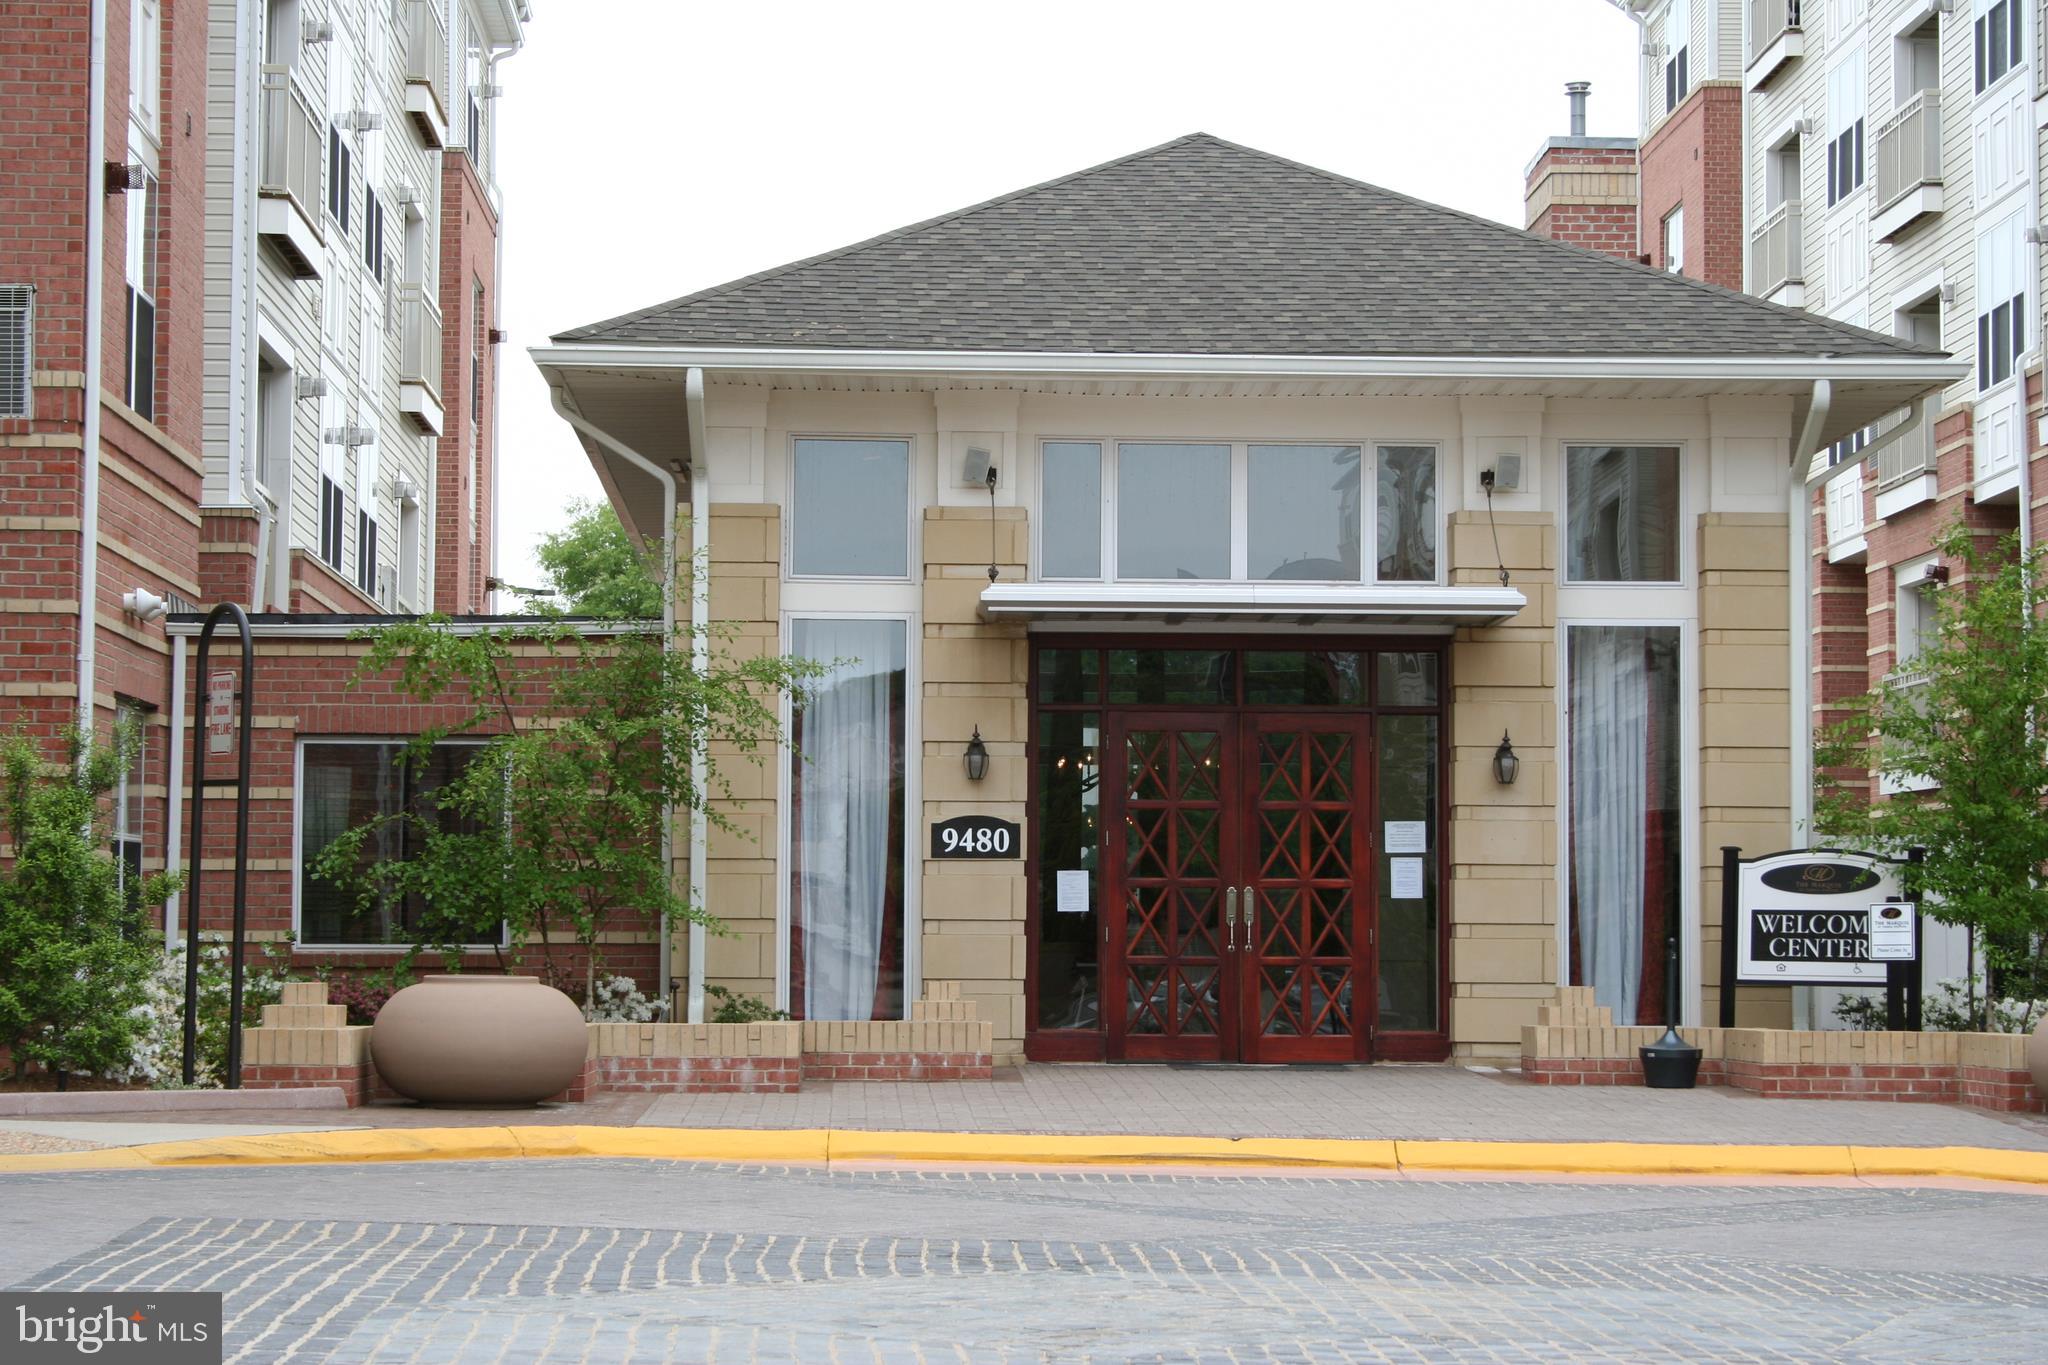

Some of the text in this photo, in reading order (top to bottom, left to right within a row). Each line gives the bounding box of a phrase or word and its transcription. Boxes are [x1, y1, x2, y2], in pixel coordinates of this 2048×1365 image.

[210, 722, 232, 736] FIRE LANE
[942, 827, 1010, 852] 9480
[1756, 914, 1869, 934] WELCOM
[1769, 937, 1869, 958] CENTER
